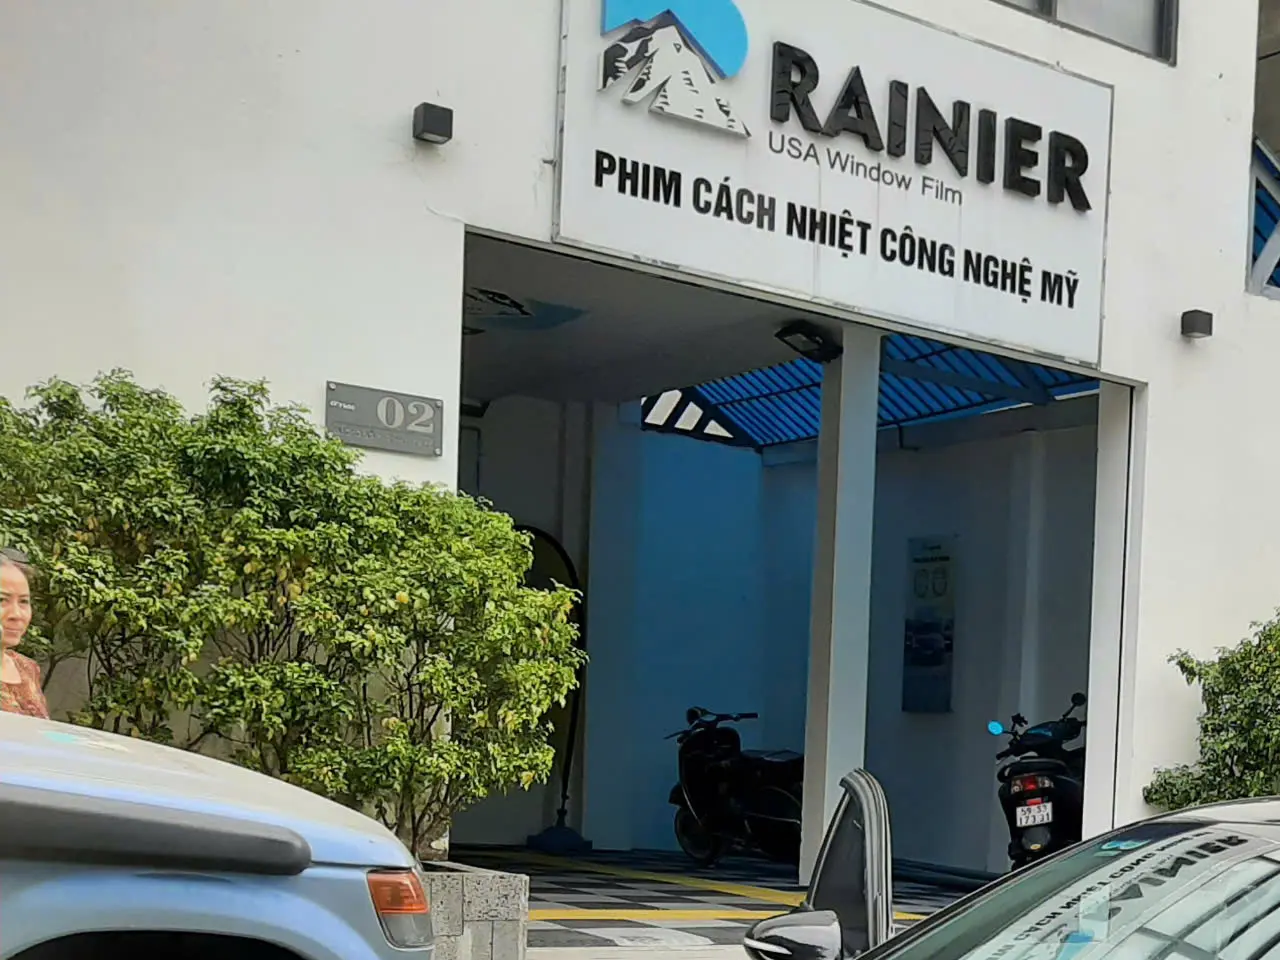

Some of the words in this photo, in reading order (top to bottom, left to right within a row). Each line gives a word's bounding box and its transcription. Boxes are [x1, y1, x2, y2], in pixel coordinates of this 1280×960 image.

[768, 133, 821, 166] USA
[827, 148, 912, 191] Window
[921, 175, 963, 206] Film
[769, 40, 1093, 212] RAINIER
[594, 149, 682, 209] PHIM
[692, 174, 777, 232] CÁCH
[786, 202, 872, 259] NHIỆT
[879, 225, 956, 276] CÔNG
[963, 251, 1033, 304] NGHỆ
[1039, 269, 1080, 309] MỸ
[376, 396, 435, 434] 02
